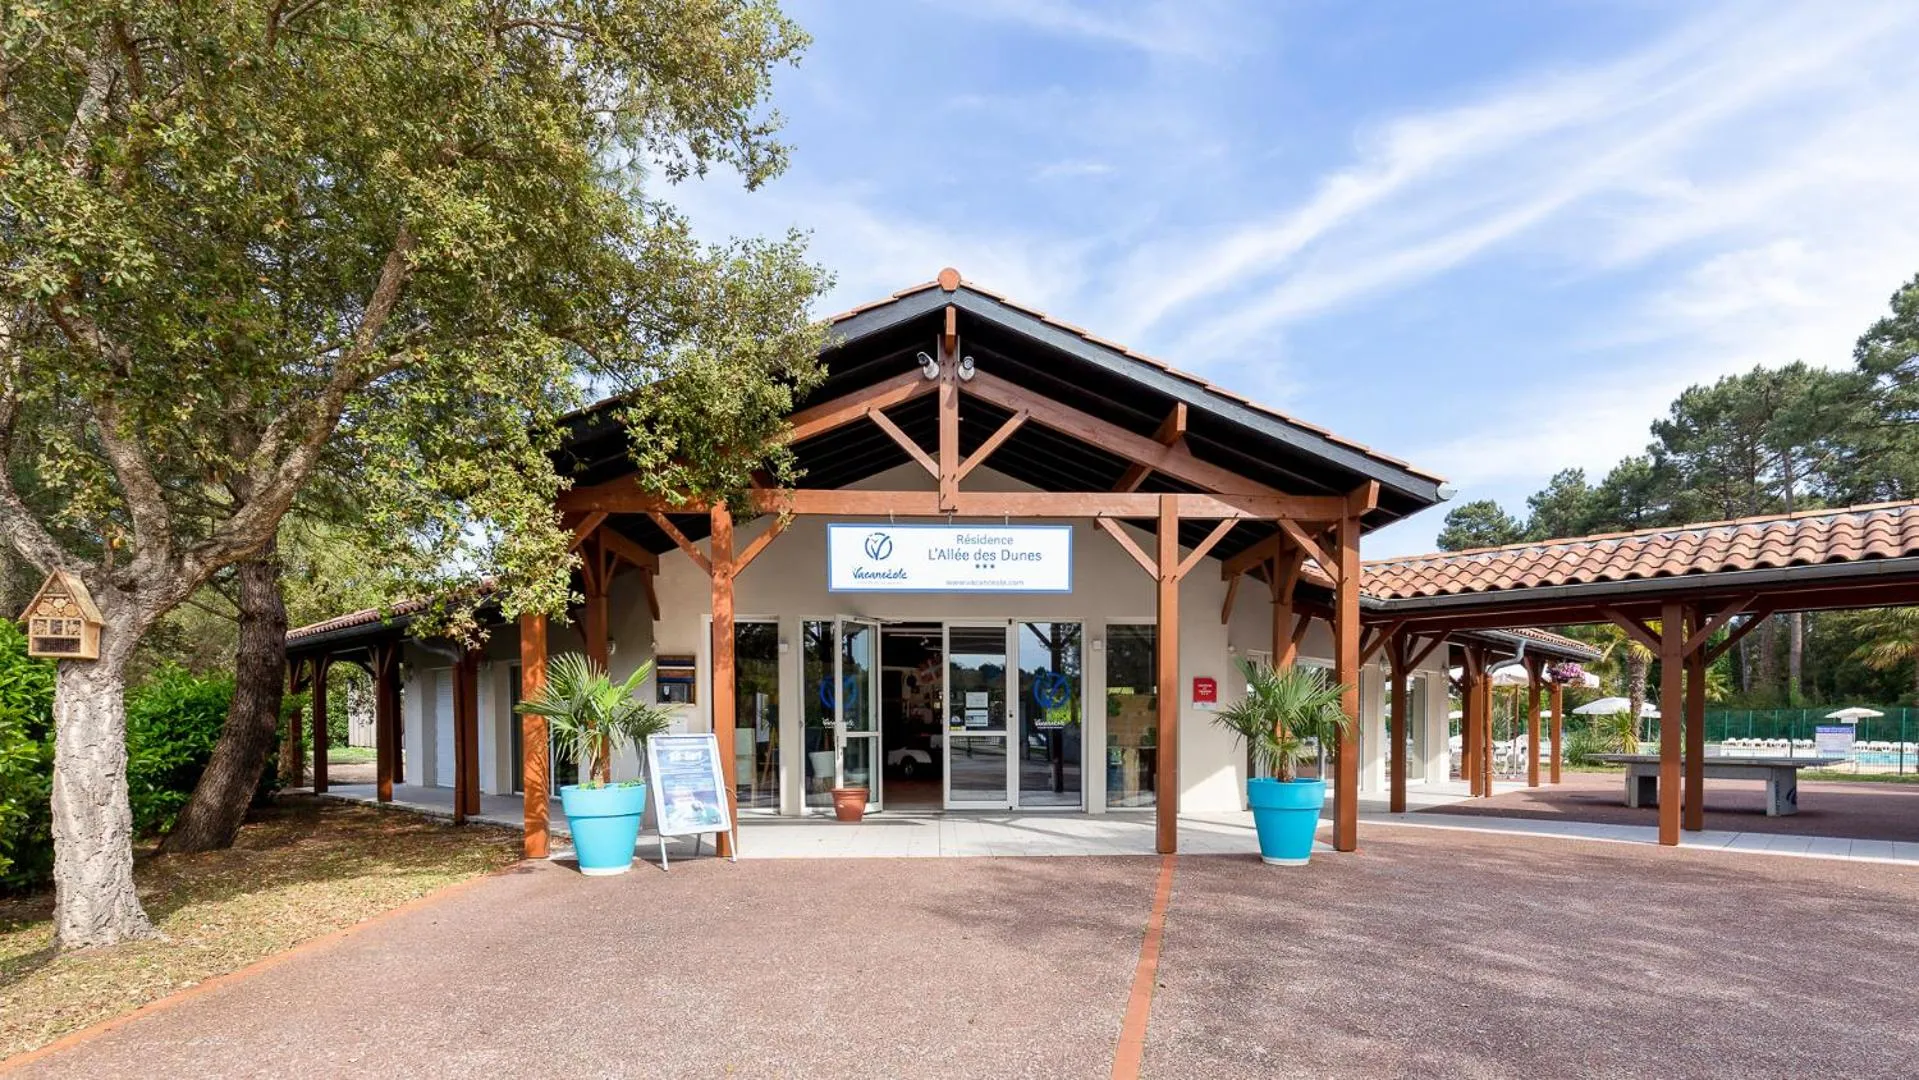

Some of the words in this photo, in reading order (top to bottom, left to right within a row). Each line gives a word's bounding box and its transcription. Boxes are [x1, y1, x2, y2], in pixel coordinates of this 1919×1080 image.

[956, 533, 1014, 545] Résidence
[928, 548, 969, 561] L'Allée
[973, 548, 996, 561] des
[1001, 549, 1042, 561] Dunes
